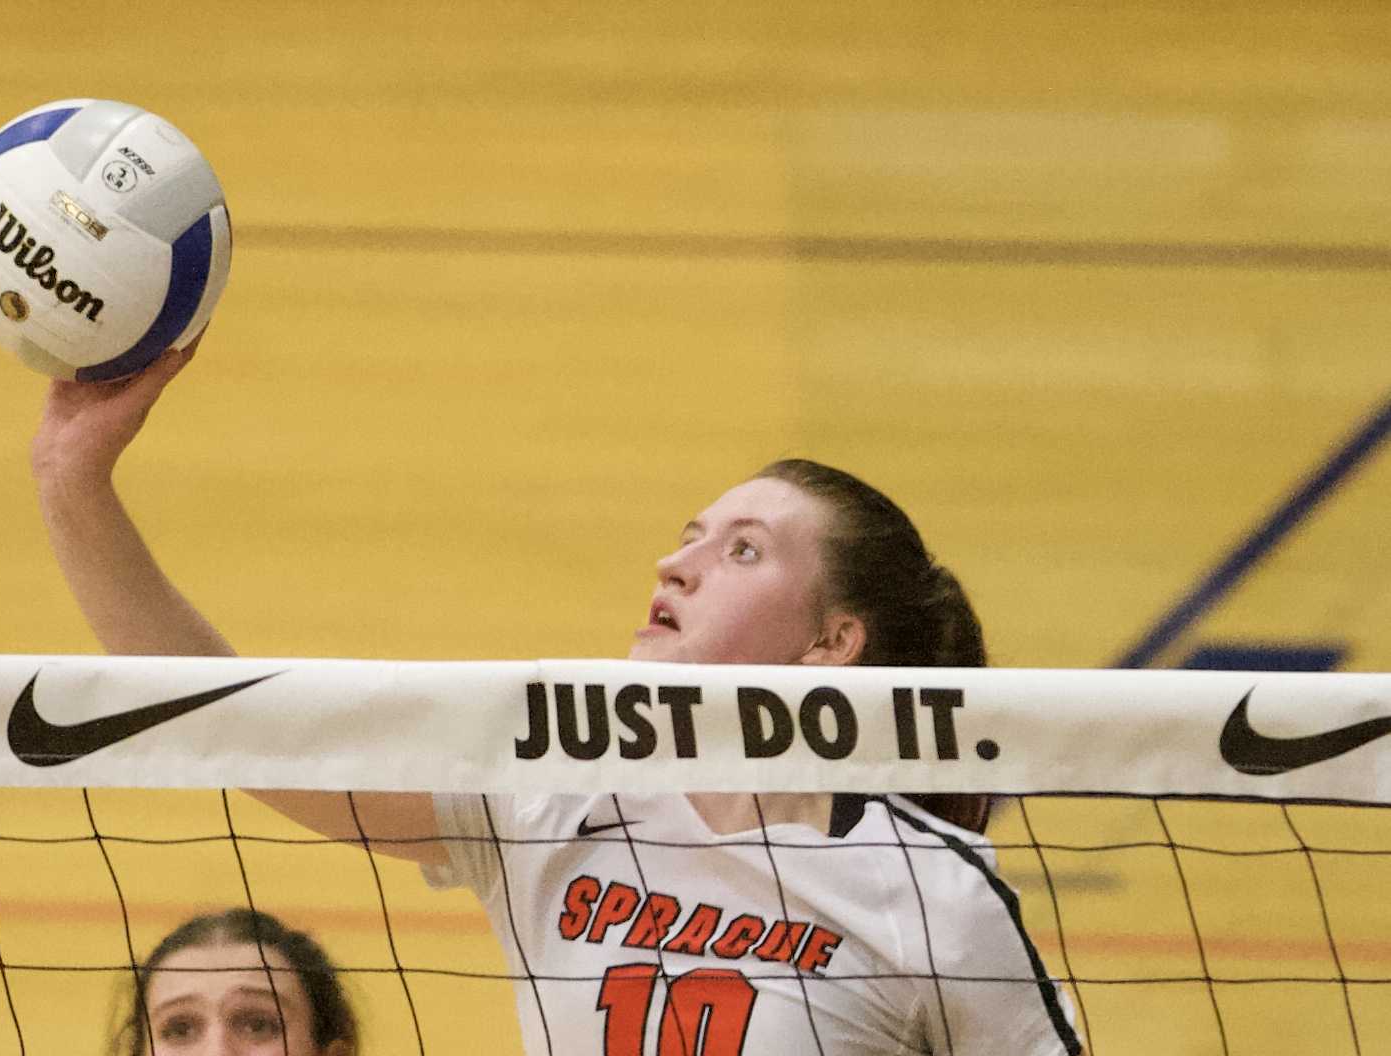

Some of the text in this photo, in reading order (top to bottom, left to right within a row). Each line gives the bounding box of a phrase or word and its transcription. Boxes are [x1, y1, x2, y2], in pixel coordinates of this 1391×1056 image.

[515, 682, 1001, 761] JUST DO IT.
[558, 874, 844, 977] SPRAGUE
